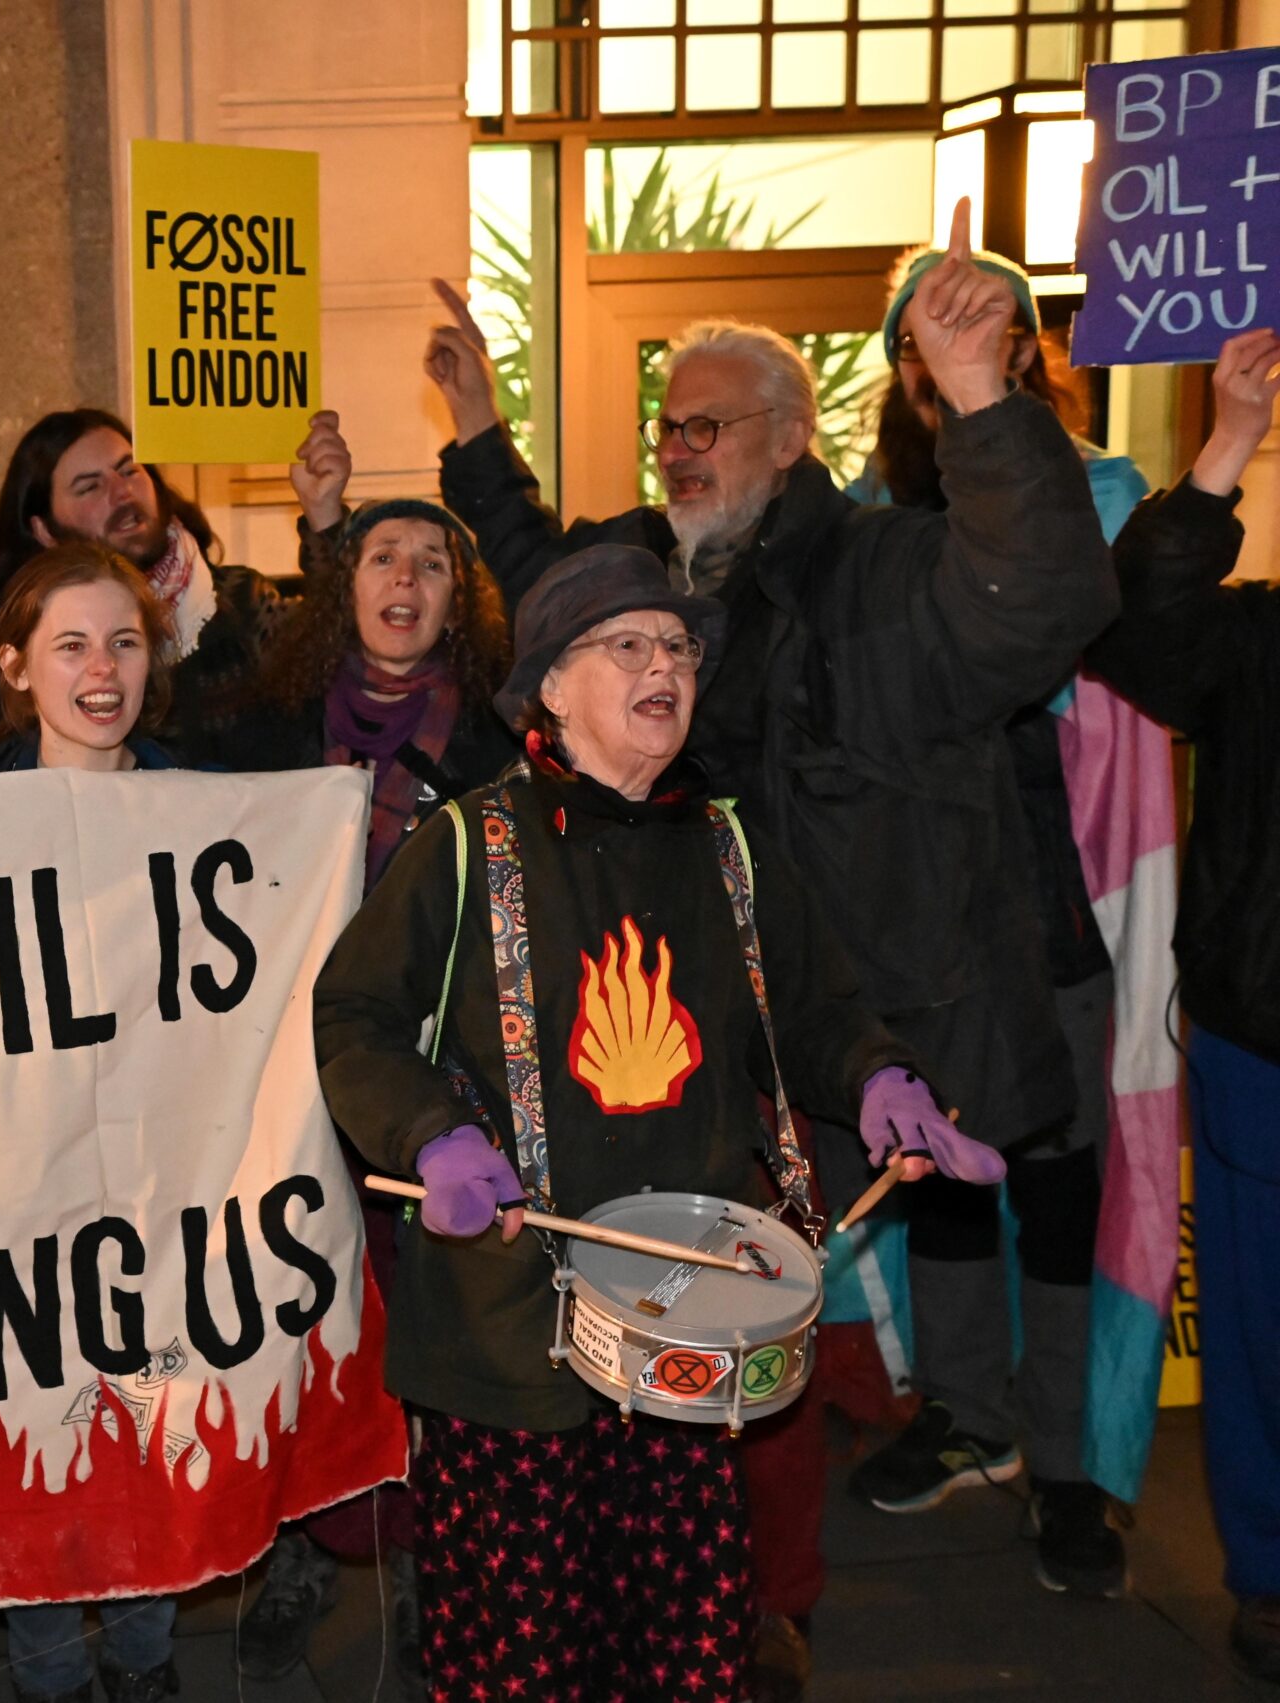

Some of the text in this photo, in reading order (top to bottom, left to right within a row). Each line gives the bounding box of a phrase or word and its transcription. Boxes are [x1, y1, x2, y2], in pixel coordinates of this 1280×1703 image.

[1115, 68, 1223, 143] BP
[1101, 155, 1207, 223] OIL
[1108, 221, 1268, 282] WILL
[179, 280, 277, 341] FREE
[1116, 283, 1257, 352] YOU
[147, 347, 308, 408] LONDON
[148, 838, 257, 1022] IS
[181, 1174, 337, 1369] US
[576, 1332, 613, 1367] END THE
[579, 1321, 610, 1351] ILLEGAL
